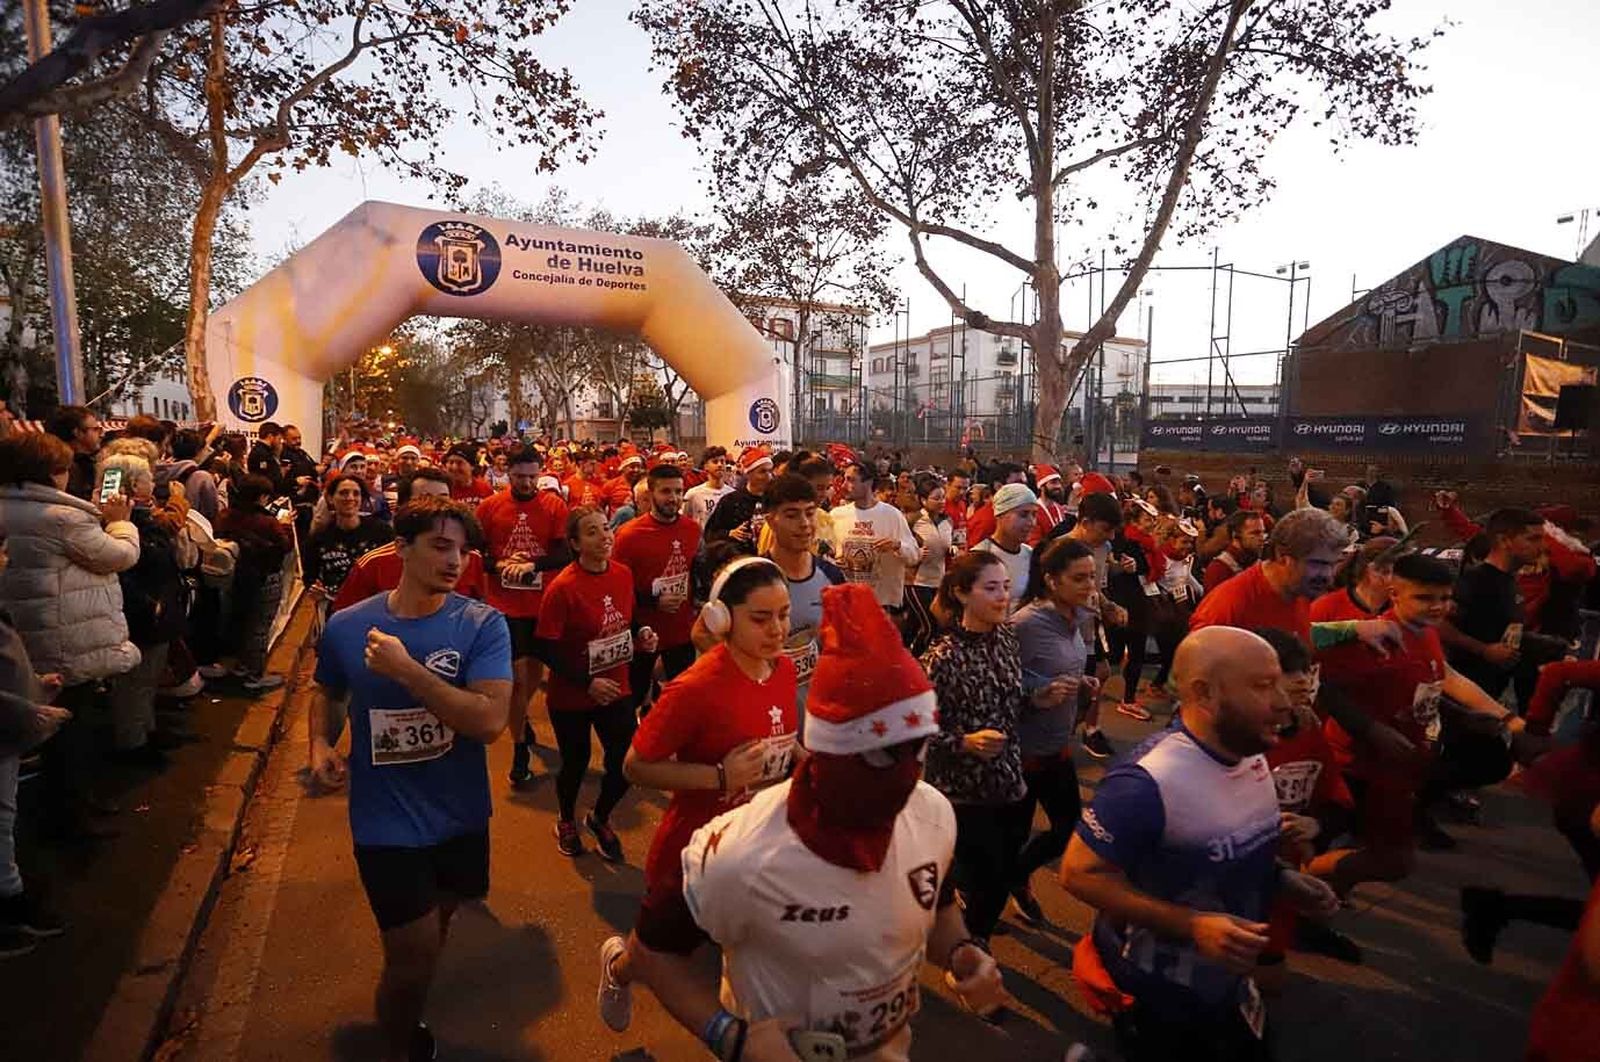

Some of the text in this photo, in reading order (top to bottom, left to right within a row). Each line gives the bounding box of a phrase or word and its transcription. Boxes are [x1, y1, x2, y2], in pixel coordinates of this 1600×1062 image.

[505, 233, 643, 260] Ayuntamiento
[546, 254, 645, 277] de Huelva
[578, 276, 593, 286] de
[596, 278, 647, 291] Deportes
[1165, 426, 1202, 435] HYUNDAI
[1228, 425, 1271, 434] HYUNDAI
[1313, 424, 1366, 434] HYUNDAI
[1403, 423, 1466, 434] HYUNDAI
[610, 640, 630, 659] 175
[405, 723, 445, 746] 361
[780, 904, 850, 922] Zeus
